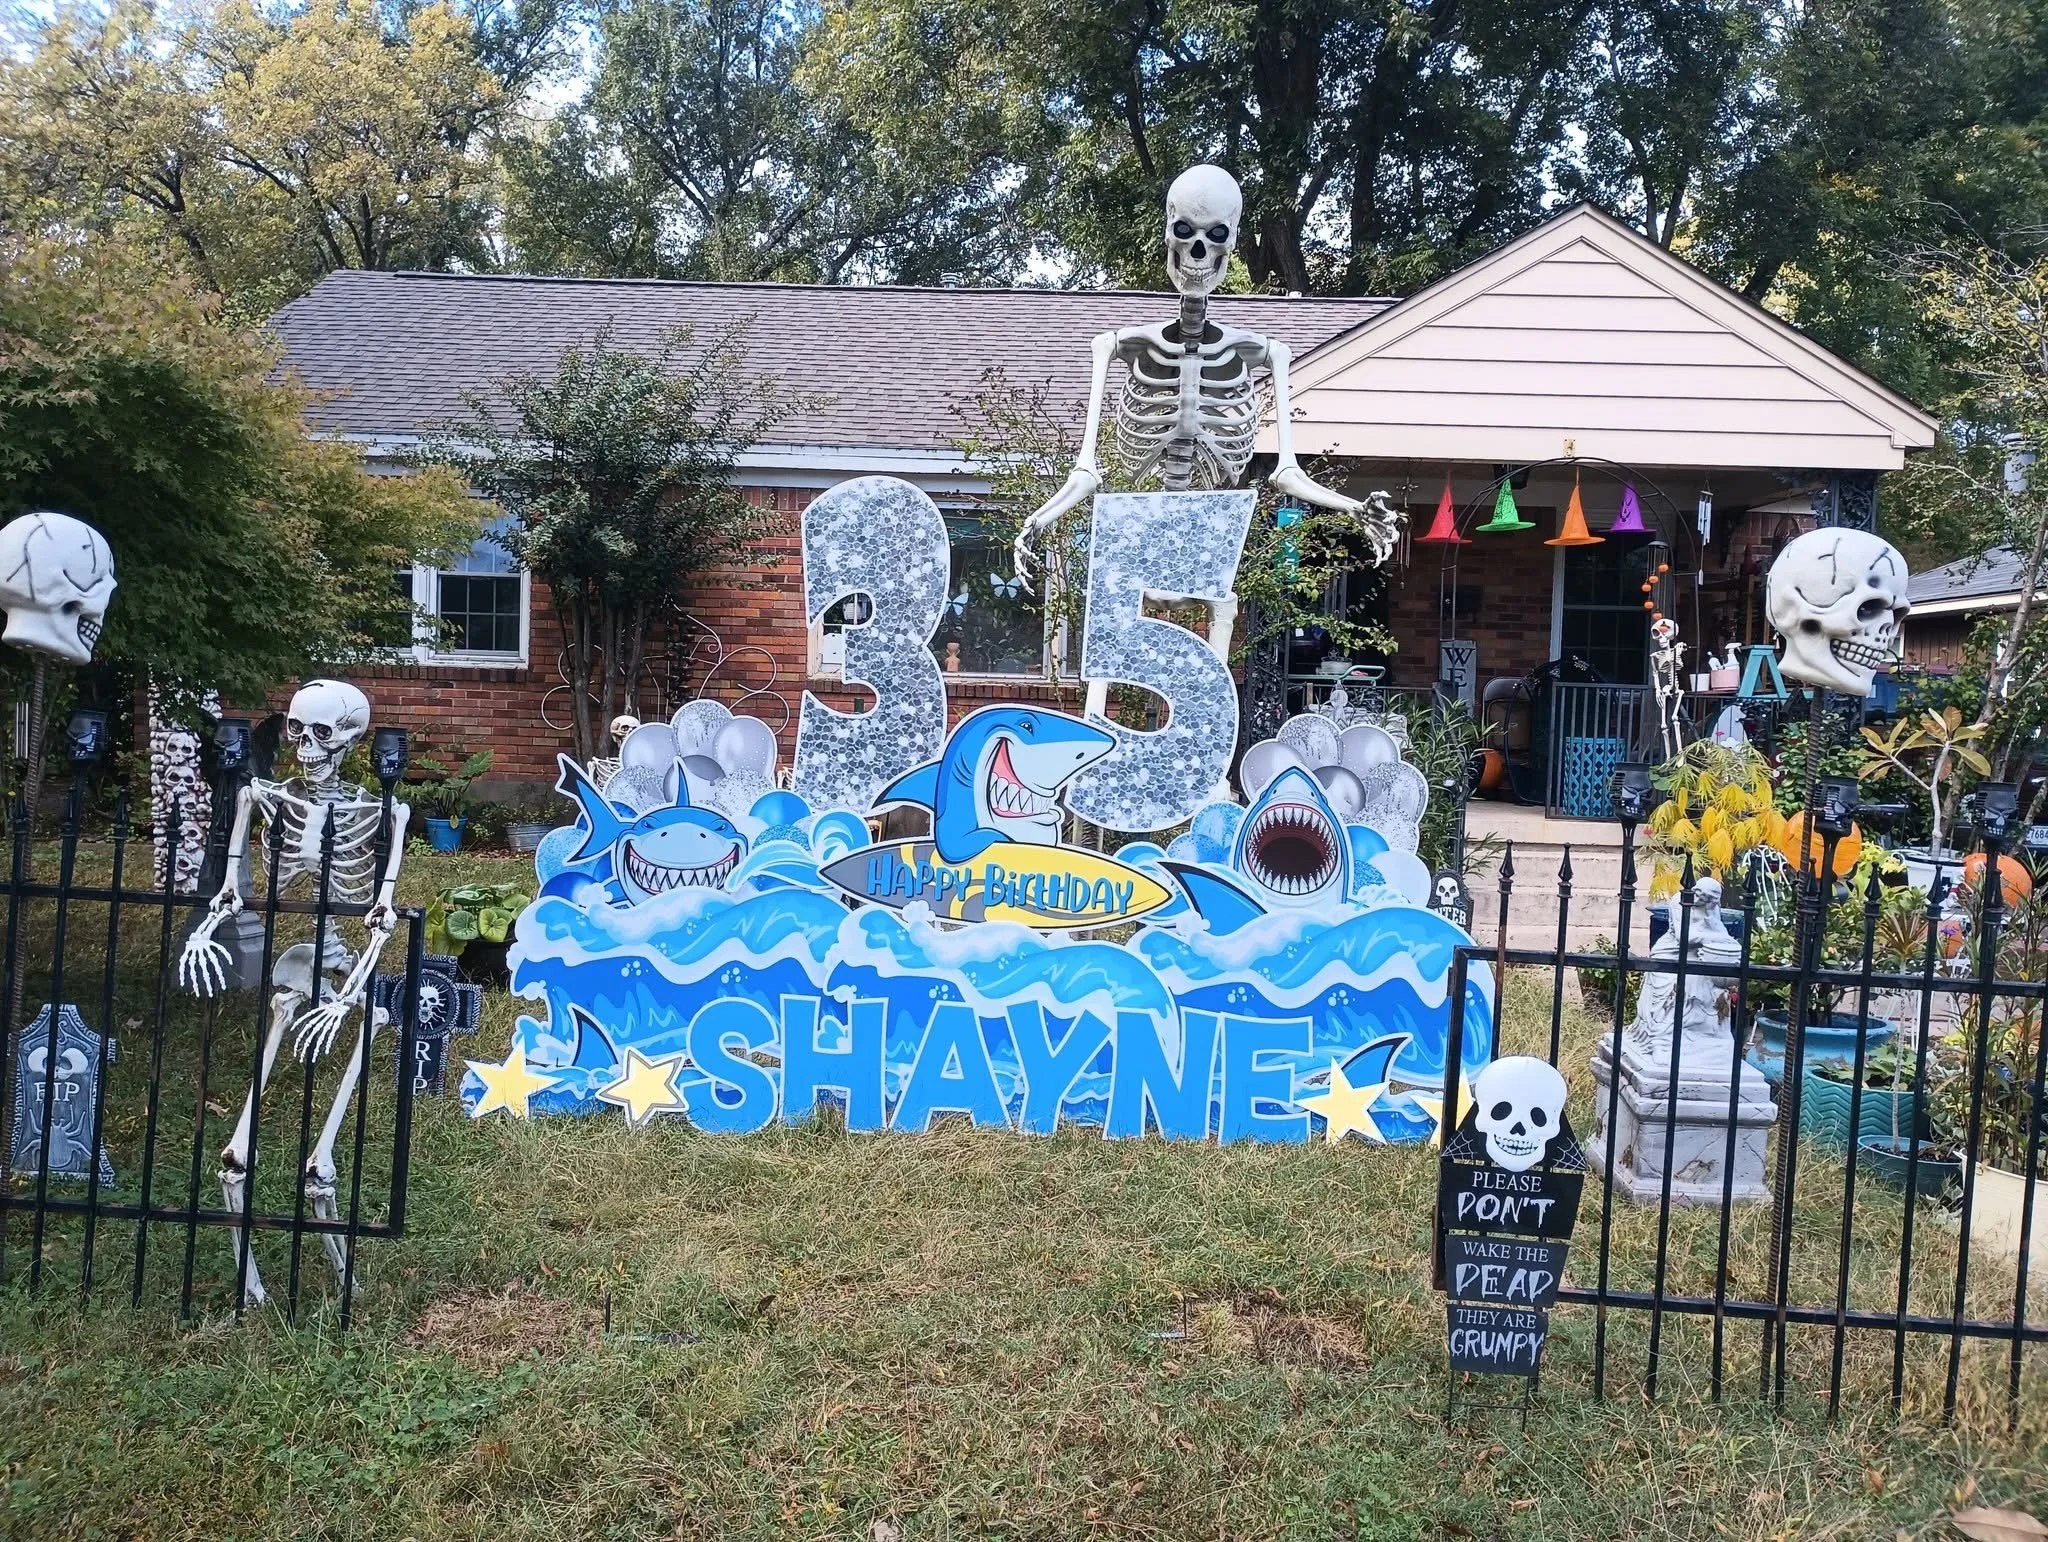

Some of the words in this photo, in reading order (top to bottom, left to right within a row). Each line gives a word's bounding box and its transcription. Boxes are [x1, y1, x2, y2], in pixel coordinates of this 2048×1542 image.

[791, 475, 1257, 833] 35
[867, 853, 972, 901] HAPPY
[682, 994, 1313, 1145] SHAYNE
[1472, 1171, 1542, 1192] PLEASE
[1457, 1191, 1555, 1228] DON'T
[1462, 1241, 1511, 1259] WAKE
[1514, 1246, 1549, 1262] THE
[1455, 1263, 1554, 1303] DEAD
[1456, 1308, 1500, 1325] THEY
[1503, 1313, 1537, 1329] ARE
[1450, 1327, 1545, 1367] GRUMPY
